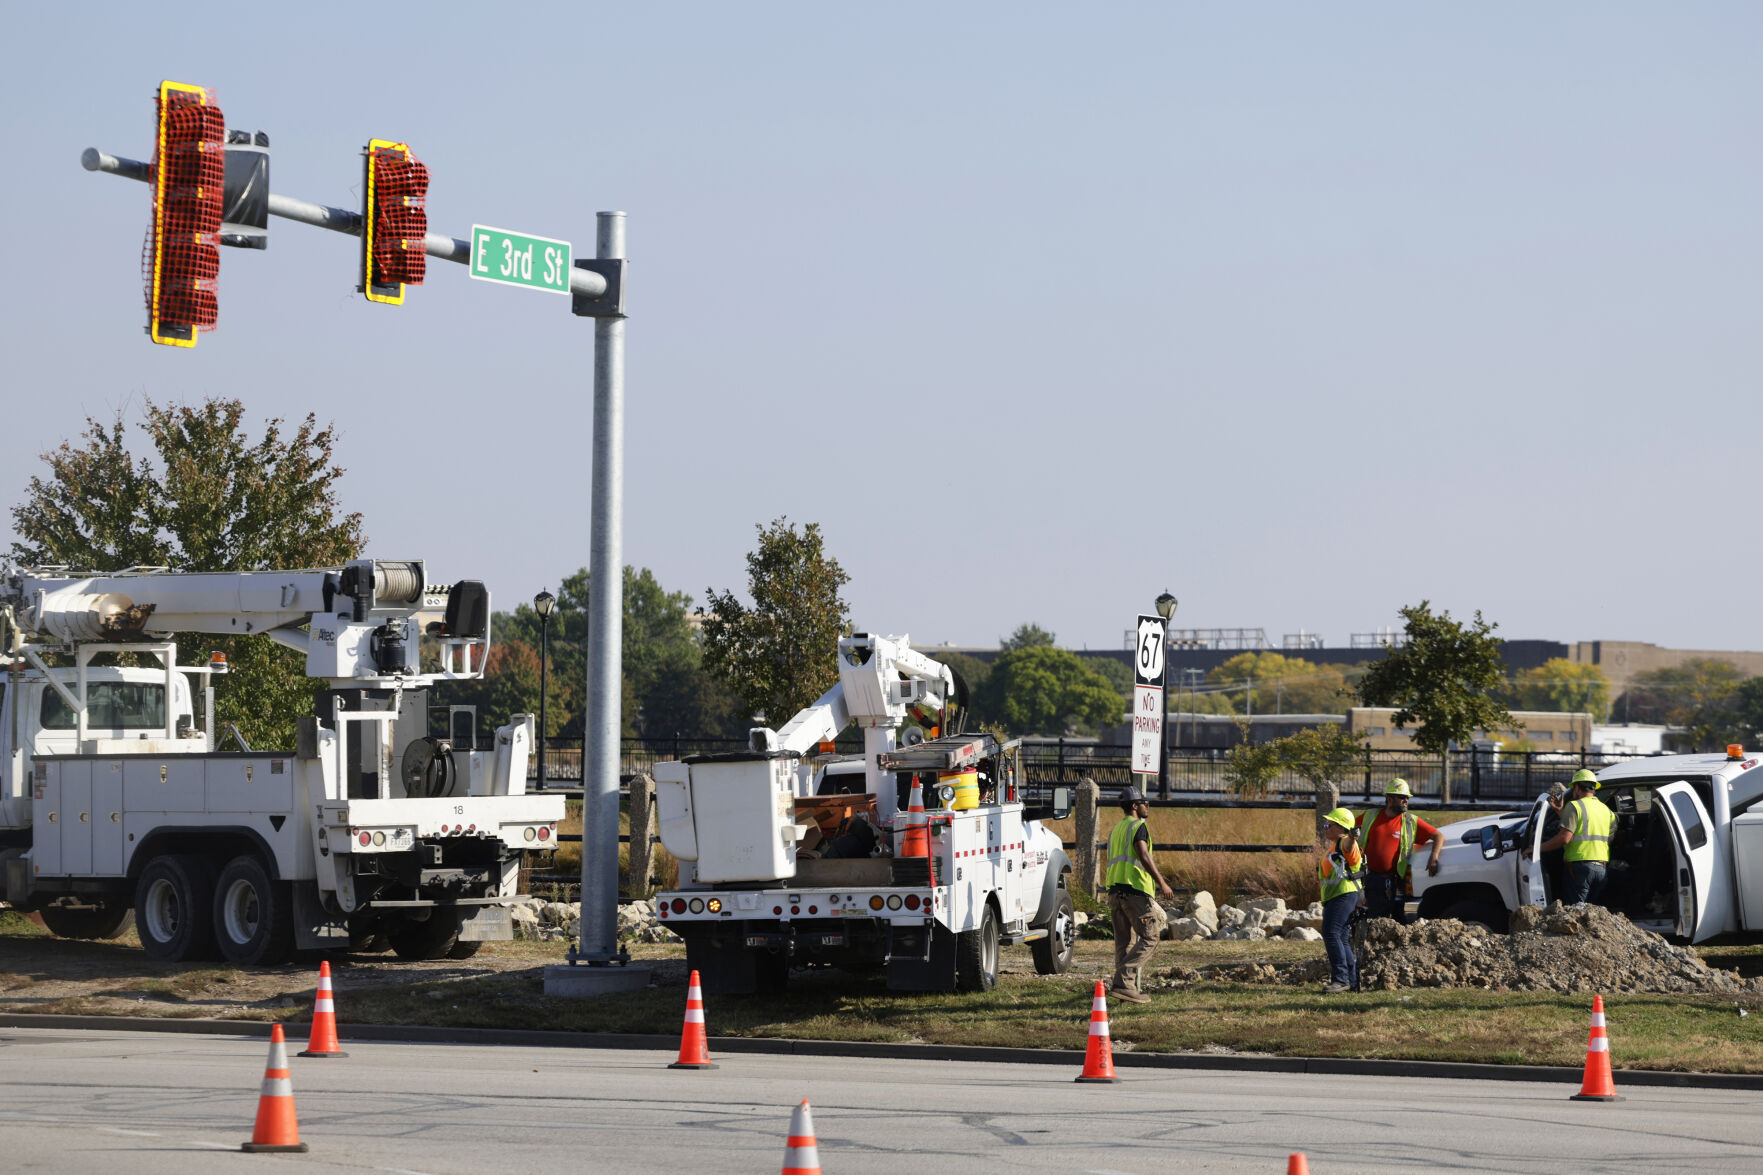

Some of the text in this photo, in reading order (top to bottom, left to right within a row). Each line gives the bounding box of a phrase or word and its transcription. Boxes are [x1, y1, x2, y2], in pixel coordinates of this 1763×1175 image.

[477, 233, 564, 286] E 3rd St
[1141, 633, 1160, 669] 67
[1142, 695, 1155, 712] NO
[1135, 715, 1160, 734] PARKING
[1141, 738, 1152, 749] ANY
[1140, 753, 1151, 764] TIME
[453, 805, 464, 815] 18
